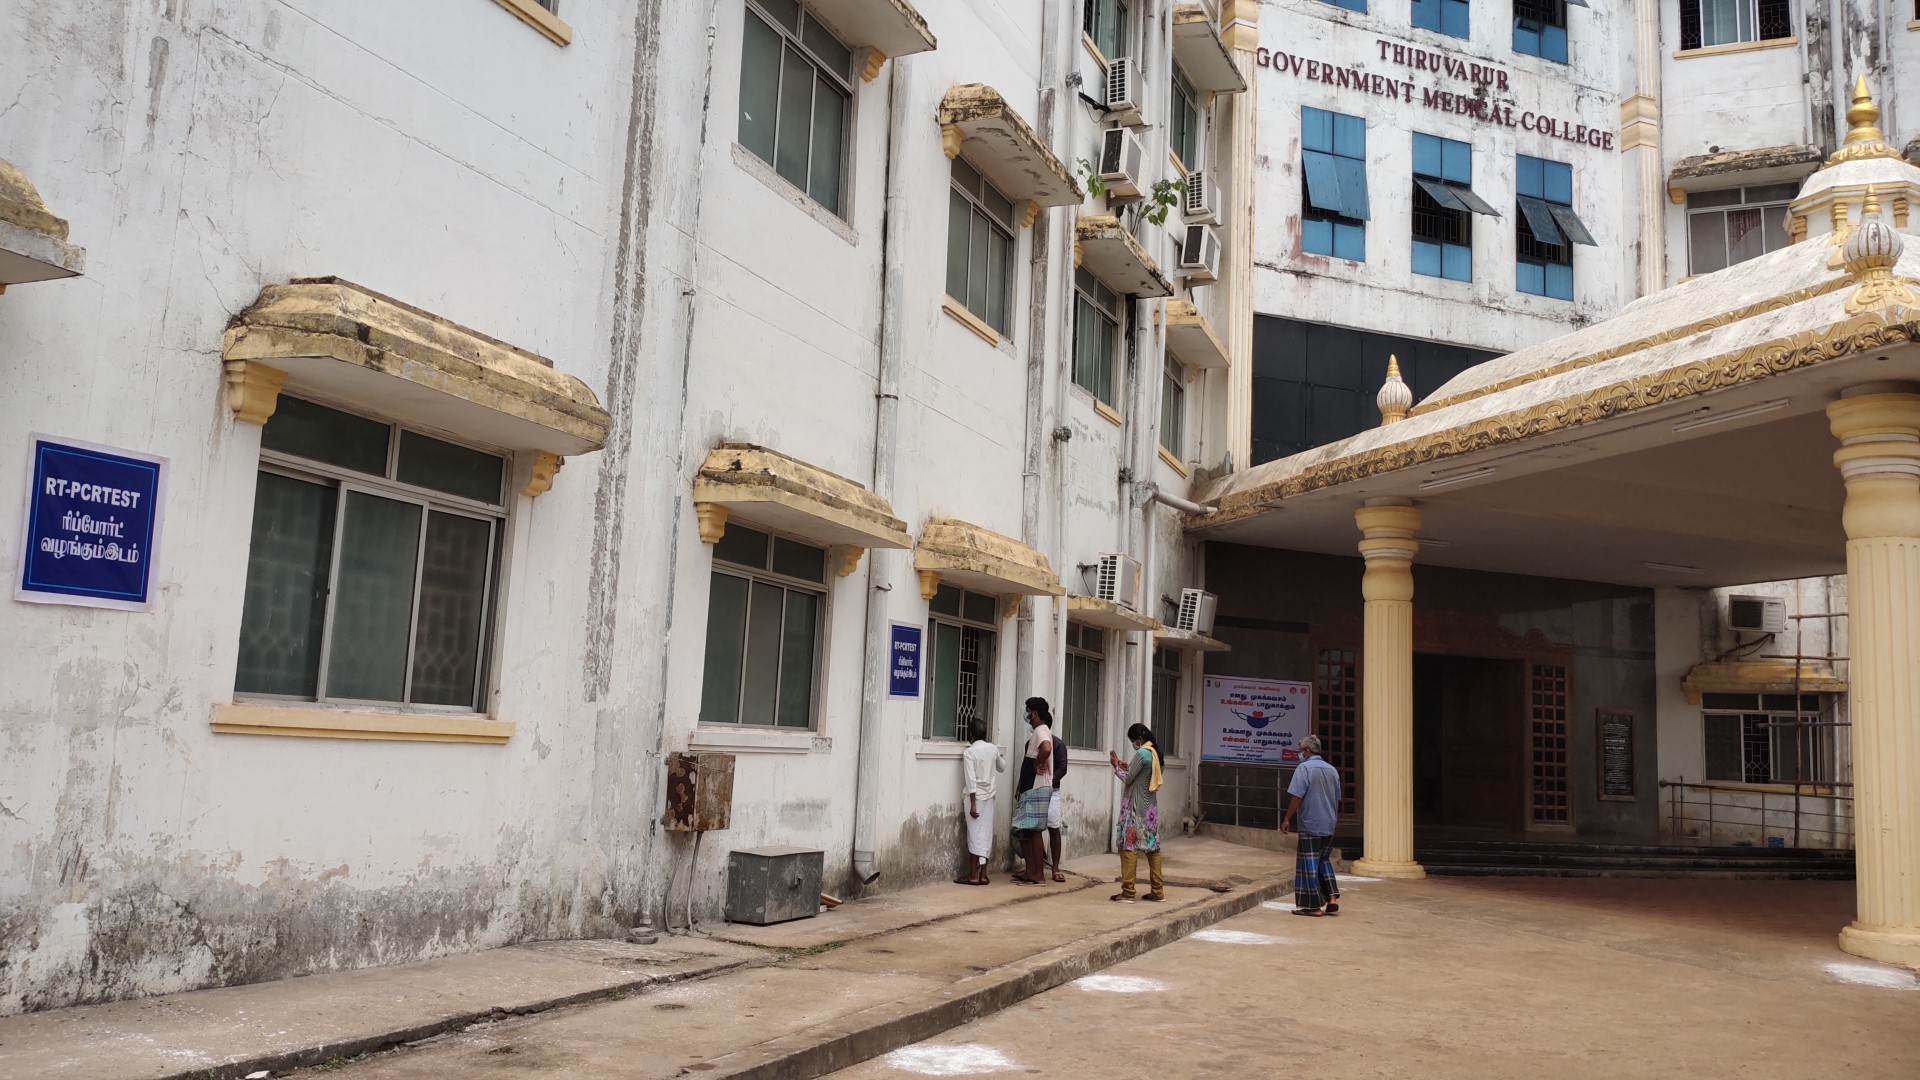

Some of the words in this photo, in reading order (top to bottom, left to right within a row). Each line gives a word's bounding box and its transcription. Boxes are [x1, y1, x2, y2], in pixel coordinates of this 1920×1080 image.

[1376, 38, 1510, 91] THIRUVARUR
[1256, 47, 1416, 105] GOVERNMENT
[1422, 87, 1517, 128] MEDICAL
[1521, 110, 1614, 151] COLLEGE
[46, 477, 140, 508] RT-PCRTEST
[894, 641, 917, 652] RT-PCRTEST
